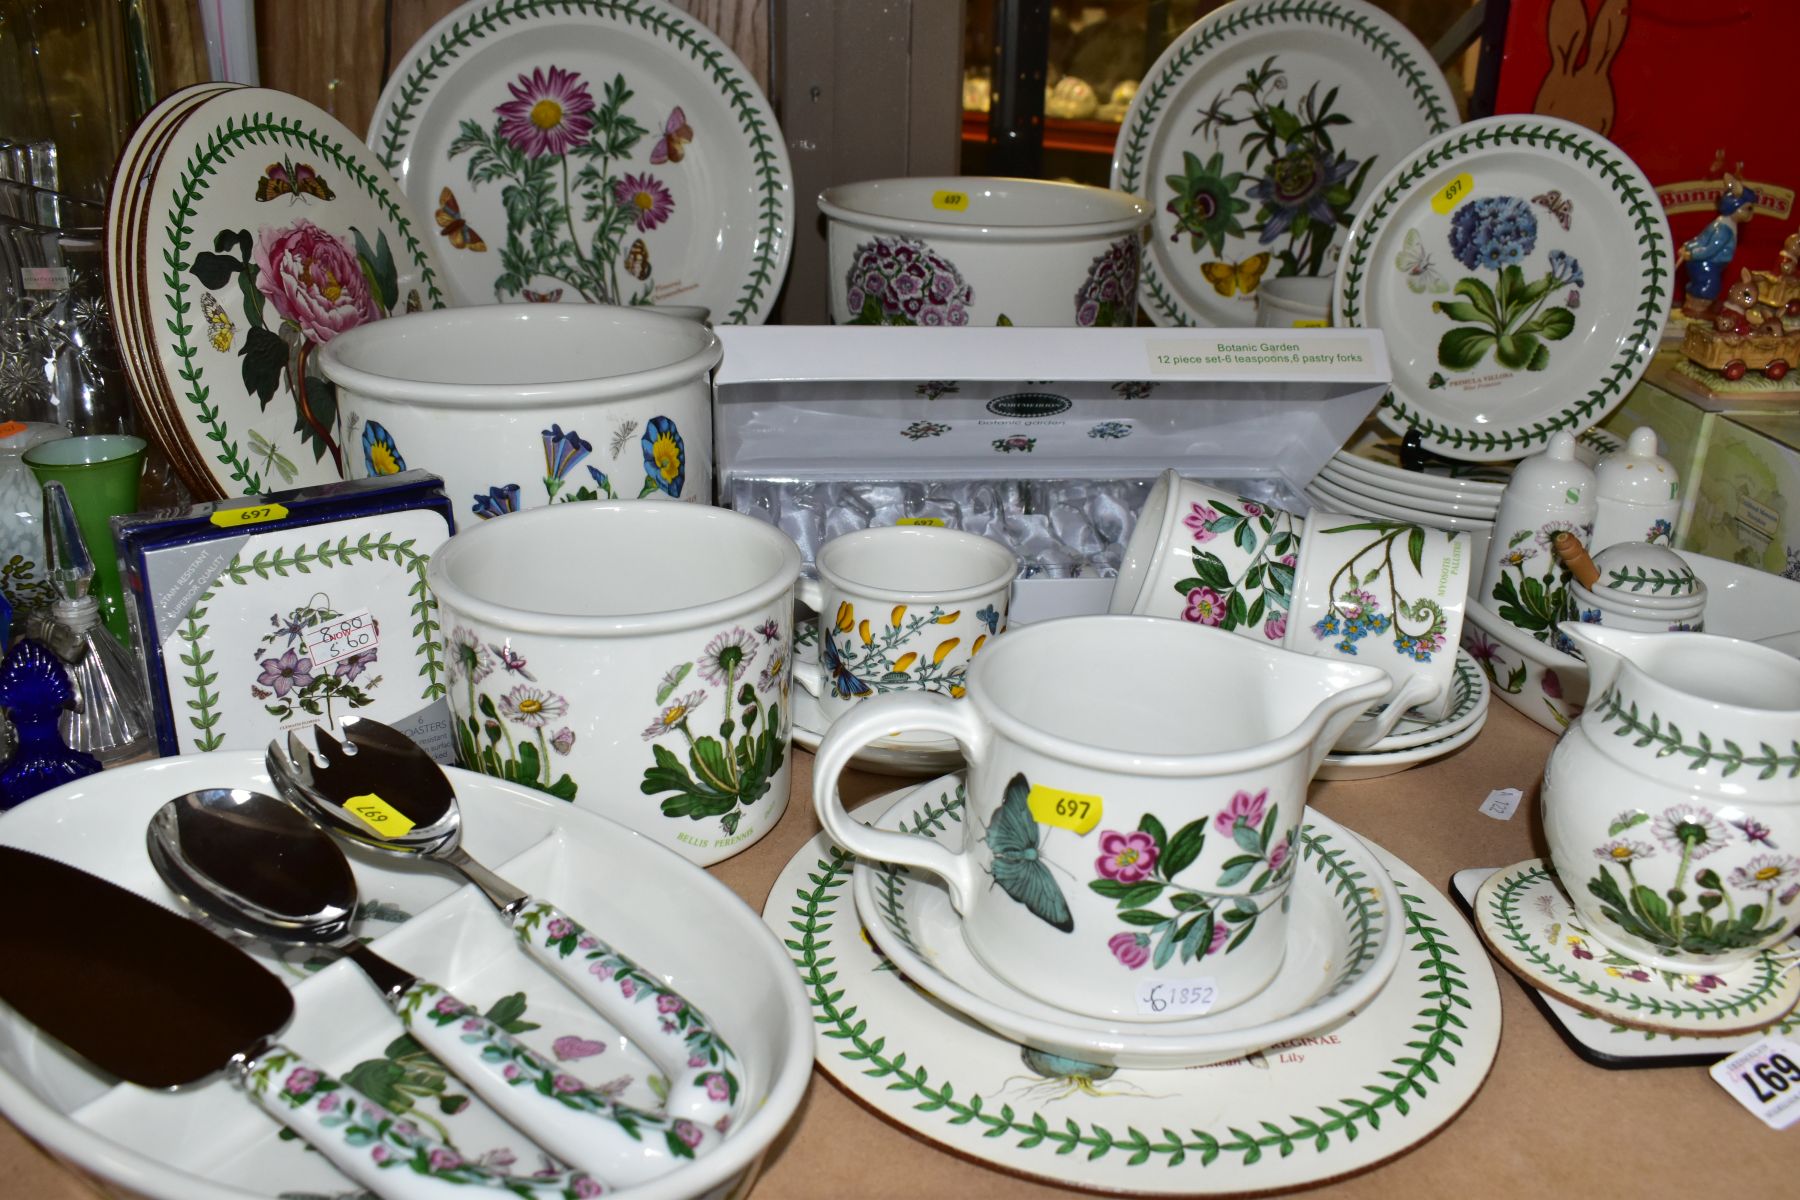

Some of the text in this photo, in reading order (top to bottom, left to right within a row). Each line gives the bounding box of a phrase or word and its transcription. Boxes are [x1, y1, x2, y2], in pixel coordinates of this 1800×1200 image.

[1446, 180, 1461, 200] 697
[1660, 186, 1788, 212] Bunnins
[944, 195, 961, 204] 697
[1217, 343, 1300, 352] Botanic Garden
[1158, 352, 1363, 366] 12 piece set-6 teaspoons,6 pastry forks
[1565, 487, 1580, 505] S
[1669, 482, 1679, 500] P
[241, 508, 271, 520] 697
[913, 518, 934, 526] 697
[160, 549, 209, 607] STAIN RESISTANT
[171, 554, 224, 619] SUPERIOR QUALITY
[356, 806, 388, 822] 697
[1056, 798, 1090, 819] 697
[677, 825, 754, 848] BELLIS PERENNIS
[1281, 1052, 1305, 1064] Lily
[1741, 1053, 1800, 1104] 697
